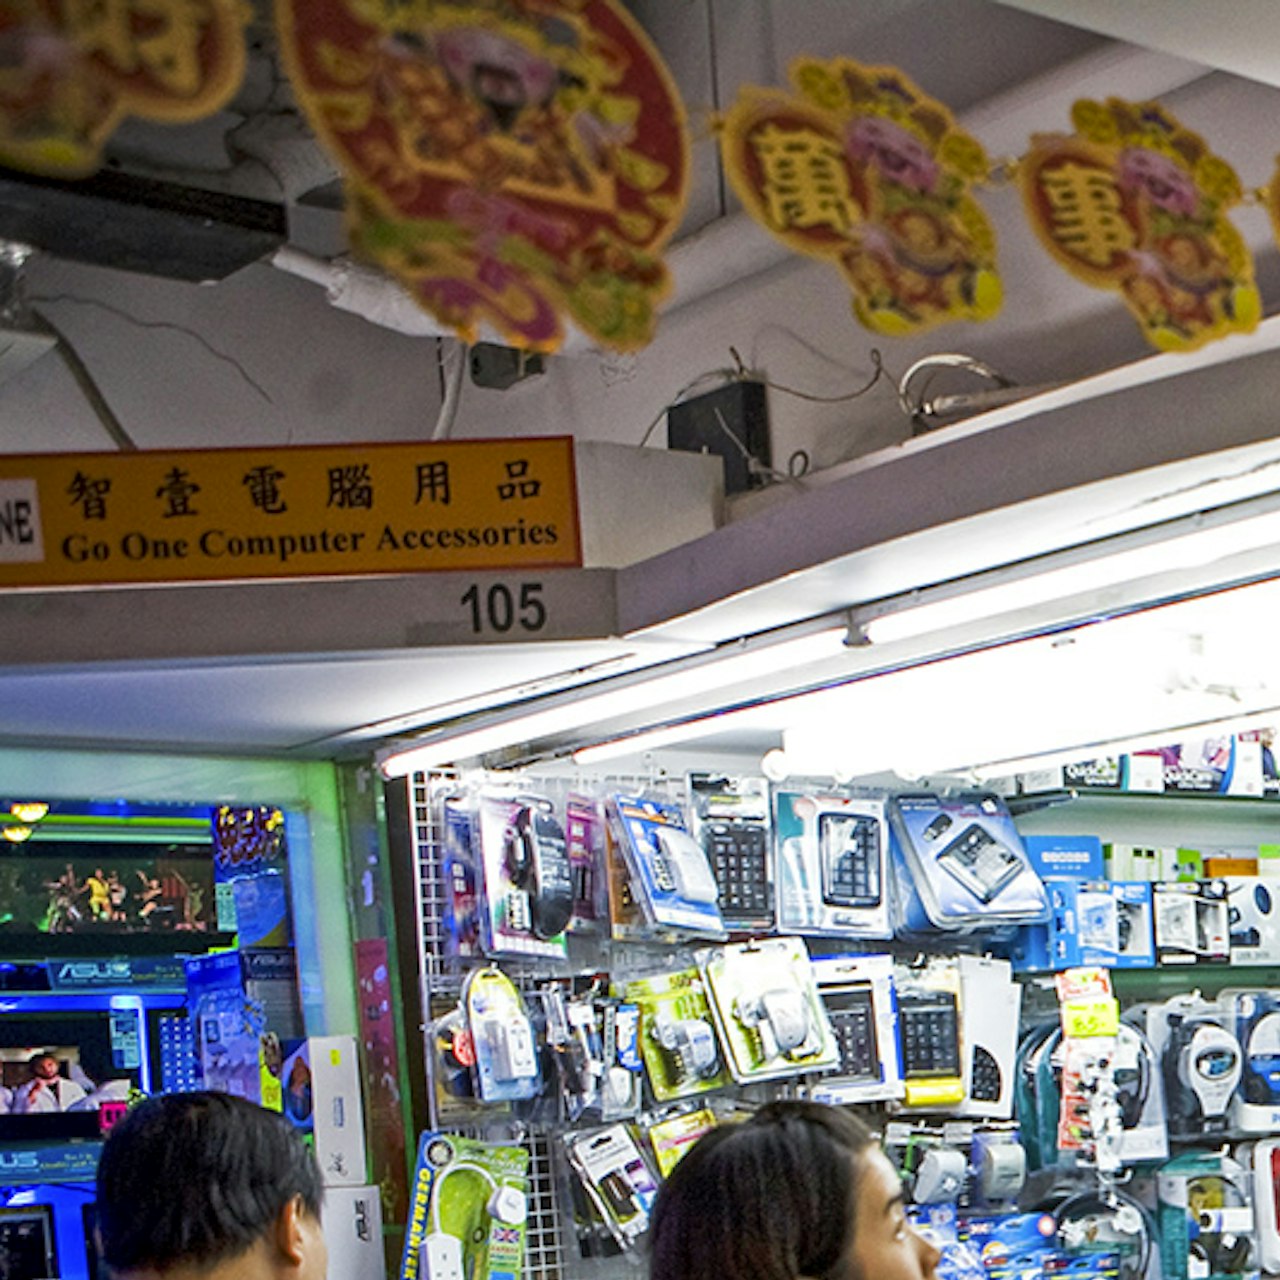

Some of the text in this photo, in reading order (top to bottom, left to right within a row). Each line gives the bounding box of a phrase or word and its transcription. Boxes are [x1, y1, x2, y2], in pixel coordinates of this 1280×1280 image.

[67, 459, 541, 520] 智壹電腦用品
[62, 519, 559, 562] Go One Computer Accessories
[461, 583, 547, 633] 105
[59, 963, 131, 978] ASUS
